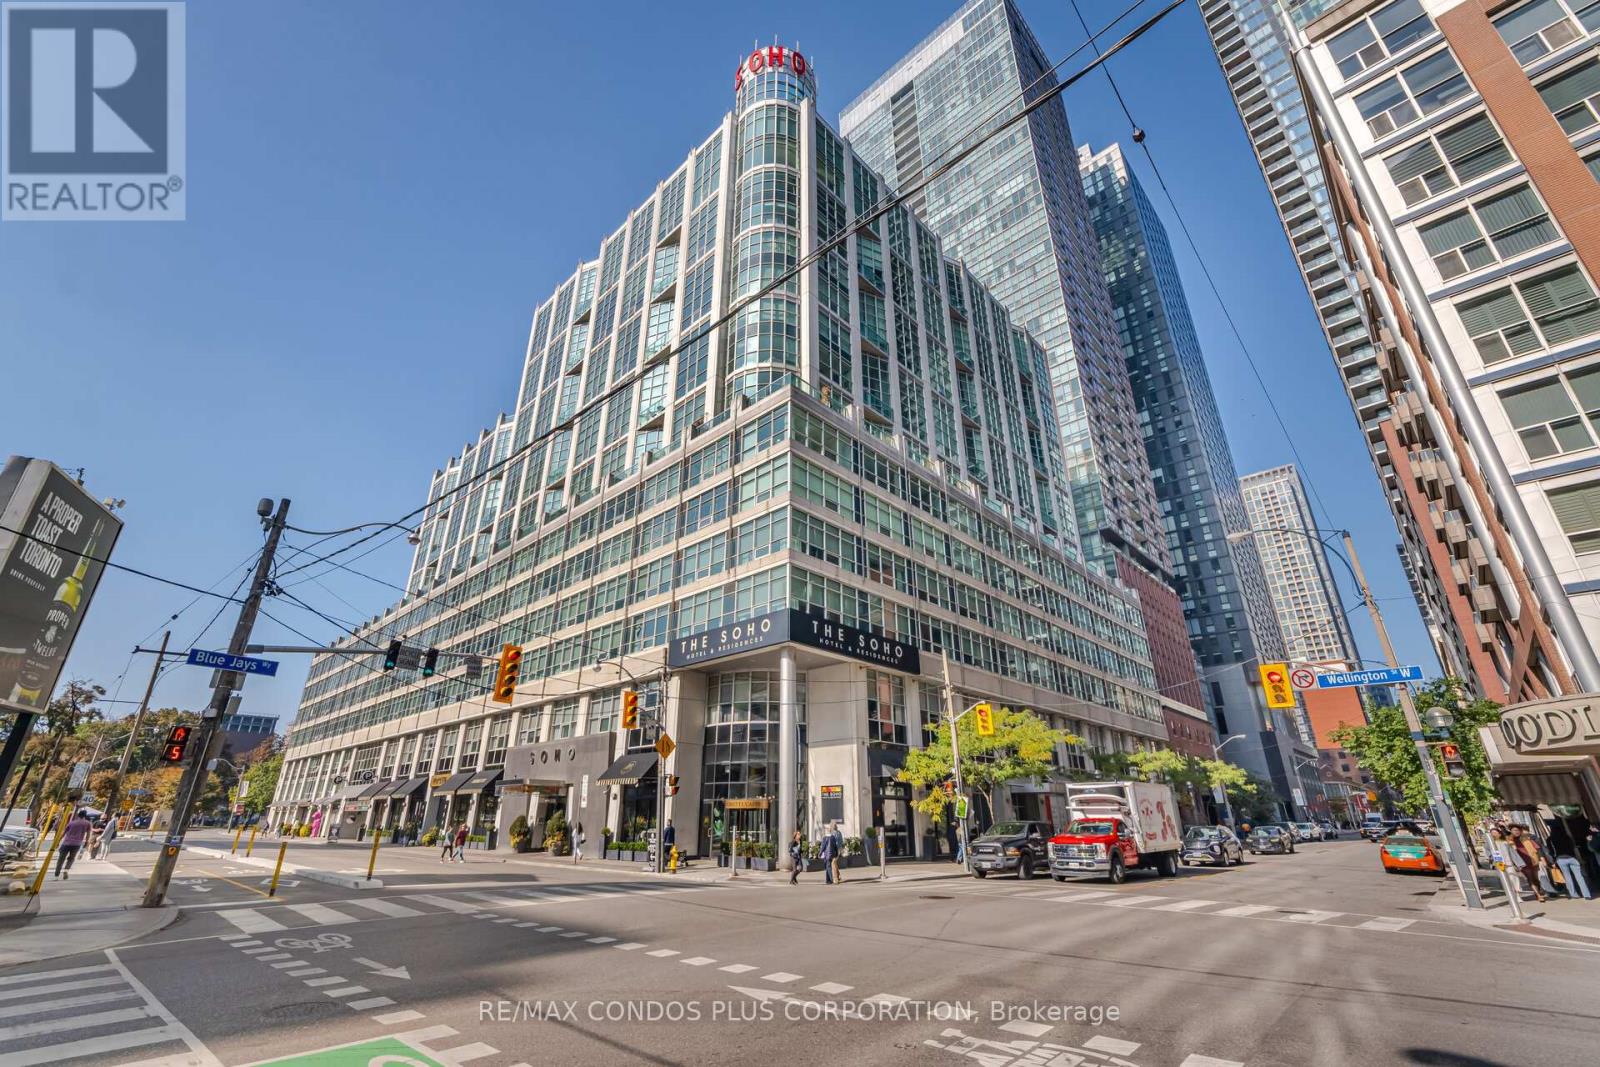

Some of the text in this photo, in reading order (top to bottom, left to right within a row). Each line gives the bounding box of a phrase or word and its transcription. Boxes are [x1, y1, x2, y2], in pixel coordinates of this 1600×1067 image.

[735, 46, 806, 91] SOHO
[41, 491, 84, 535] A PROPER
[19, 538, 63, 578] TORONTO
[681, 618, 771, 653] THE SOHO
[812, 620, 903, 658] THE SOHO
[195, 651, 226, 665] Blue
[229, 658, 257, 671] Jays
[1326, 671, 1388, 685] Wellington
[1400, 668, 1411, 678] W
[171, 746, 180, 760] 5
[529, 748, 576, 766] SOHO
